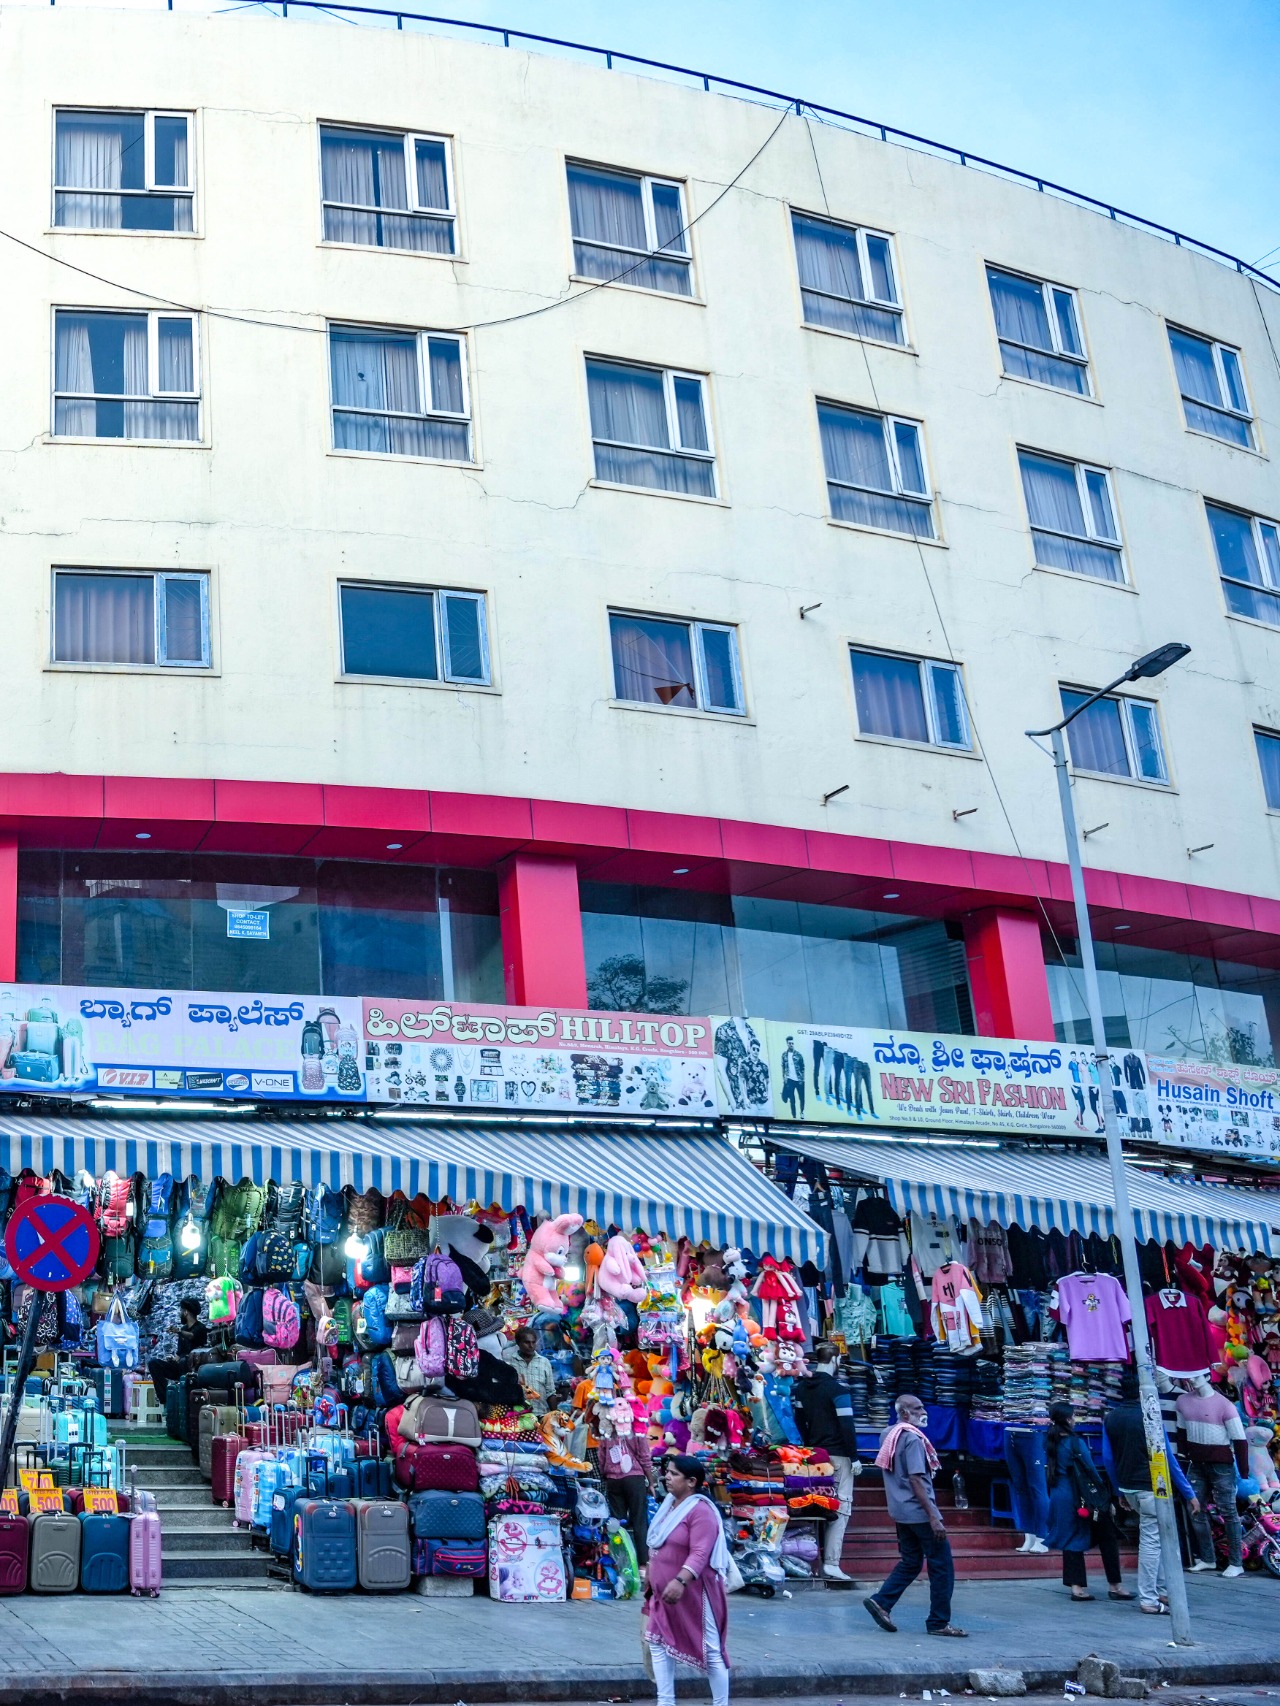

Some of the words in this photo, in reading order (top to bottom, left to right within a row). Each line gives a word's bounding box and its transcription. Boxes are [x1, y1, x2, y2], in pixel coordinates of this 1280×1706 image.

[94, 1031, 161, 1054] BAG
[171, 1036, 297, 1060] PALACE
[559, 1016, 706, 1048] HILLTOP
[879, 1073, 934, 1102] NEW
[937, 1076, 975, 1105] SRI
[976, 1078, 1067, 1111] FASHION
[1157, 1079, 1220, 1103] Husain
[1226, 1086, 1274, 1109] Shoft
[38, 1496, 60, 1511] 500
[92, 1497, 115, 1511] 500
